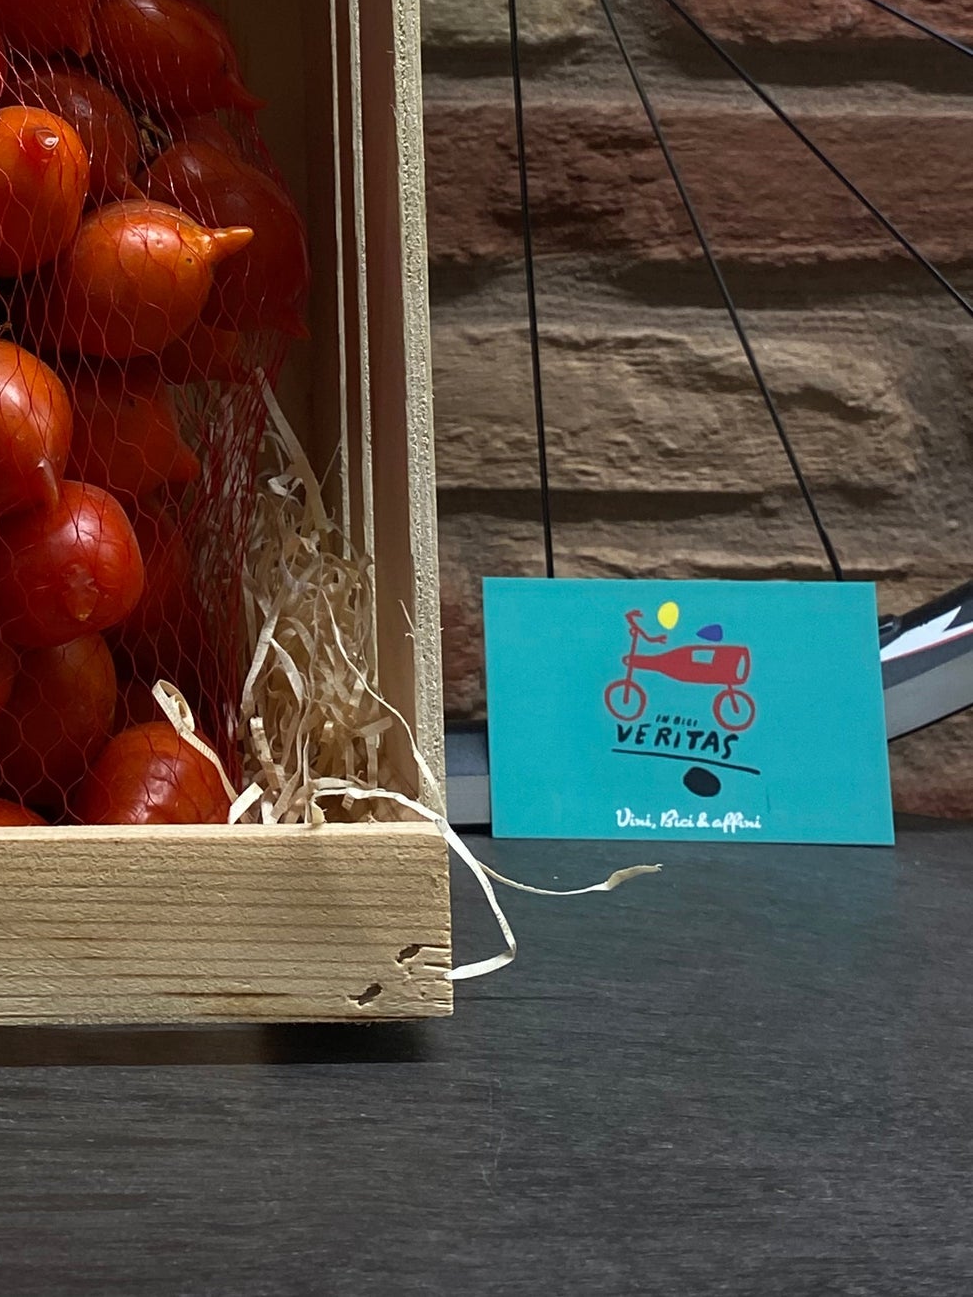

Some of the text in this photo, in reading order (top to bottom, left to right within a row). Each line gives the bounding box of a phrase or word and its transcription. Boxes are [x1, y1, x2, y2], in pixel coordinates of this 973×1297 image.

[616, 723, 739, 760] VERITAS
[615, 807, 762, 834] Vini, Bici & affini
